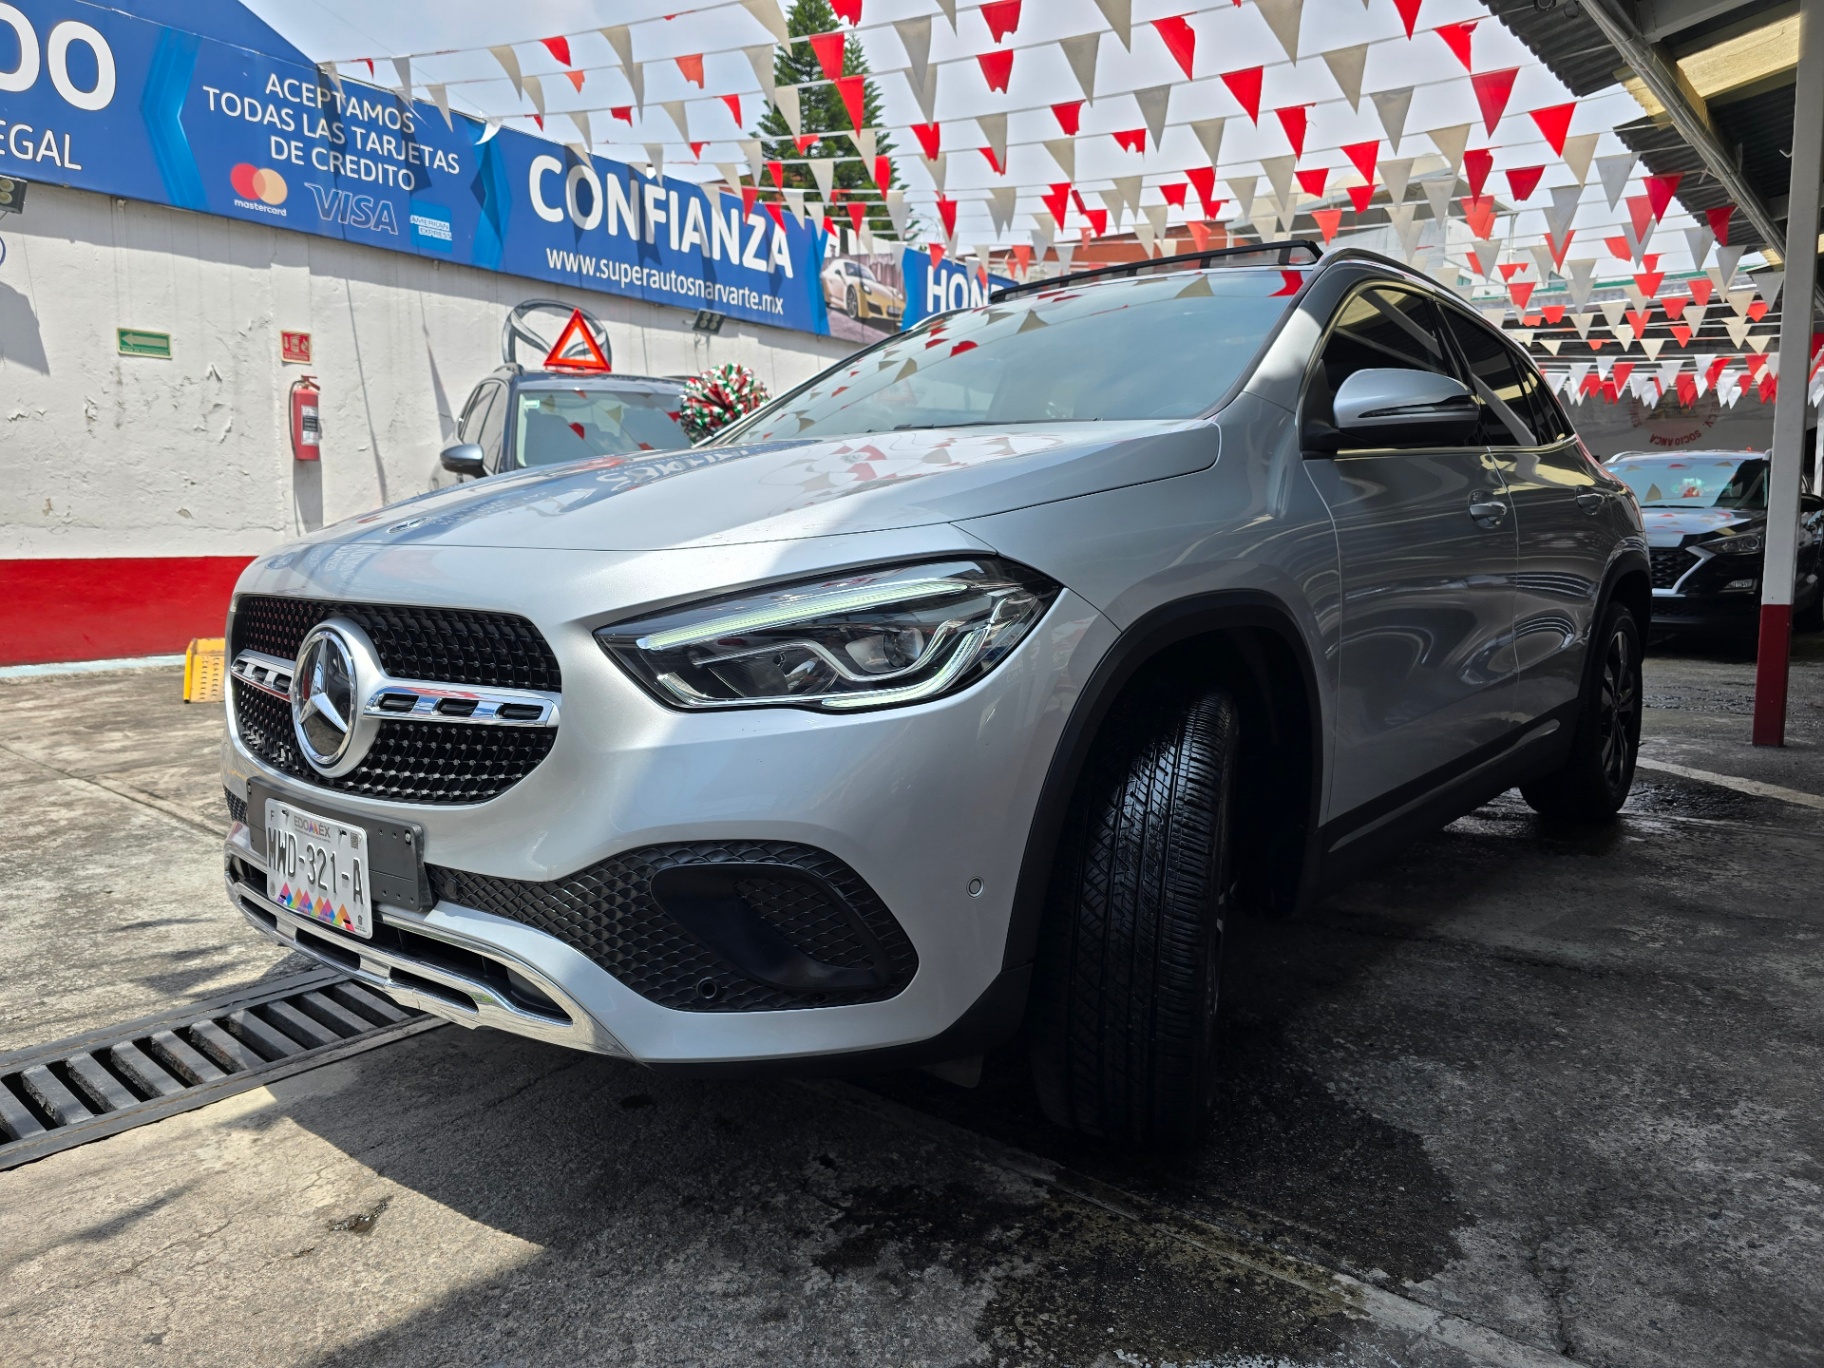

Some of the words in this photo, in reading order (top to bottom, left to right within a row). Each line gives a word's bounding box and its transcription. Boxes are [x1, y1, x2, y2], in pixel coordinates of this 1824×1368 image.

[203, 85, 296, 132] TODAS
[303, 113, 346, 145] LAS
[351, 126, 460, 175] TARJETAS
[265, 73, 415, 134] ACEPTAMOS
[270, 135, 304, 166] DE
[311, 147, 415, 191] CREDITO
[234, 198, 287, 217] mastercard
[304, 182, 398, 235] VISA
[410, 214, 450, 231] AMERICAN
[529, 154, 794, 279] CONFIANZA
[546, 247, 784, 316] www.superautosnarvarte.mx
[927, 264, 1004, 317] HON
[267, 826, 365, 907] MWD-321-A
